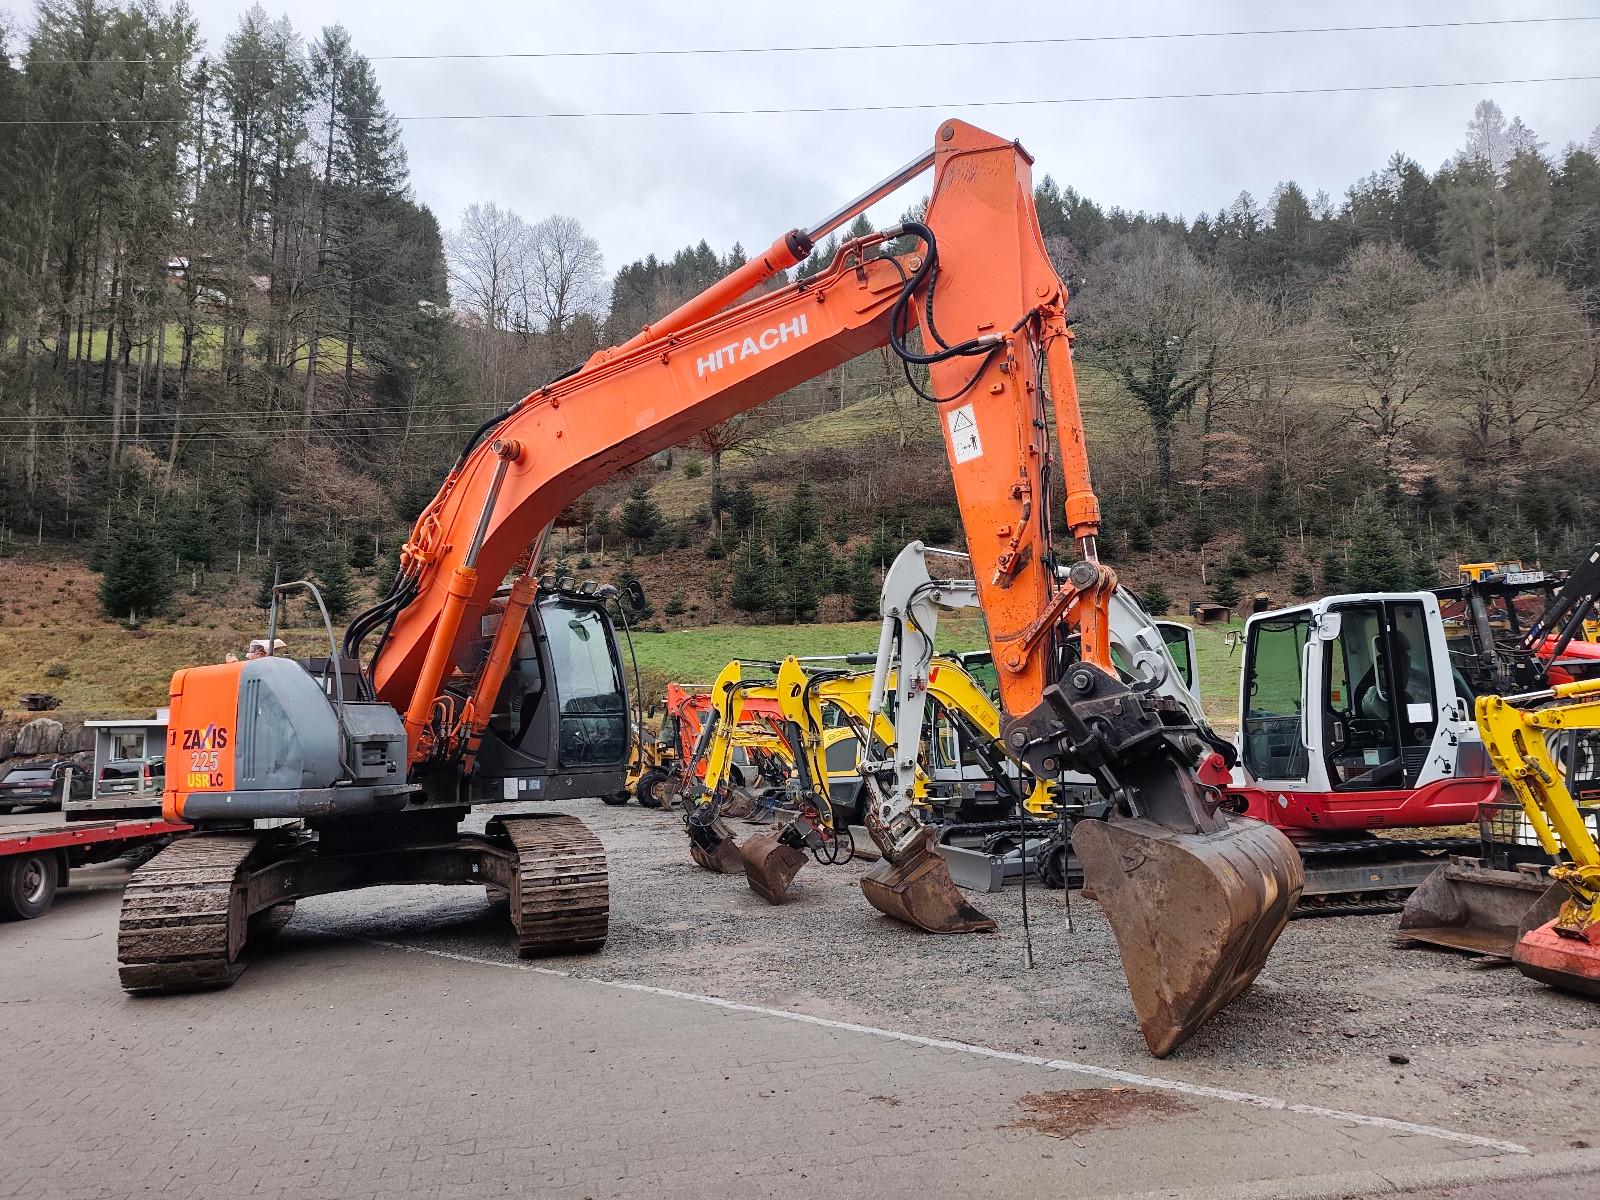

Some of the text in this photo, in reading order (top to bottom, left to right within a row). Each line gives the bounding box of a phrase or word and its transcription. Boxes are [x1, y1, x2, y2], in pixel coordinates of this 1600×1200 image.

[696, 313, 808, 378] HITACHI
[183, 723, 228, 750] ZAXIS
[191, 751, 220, 772] 225
